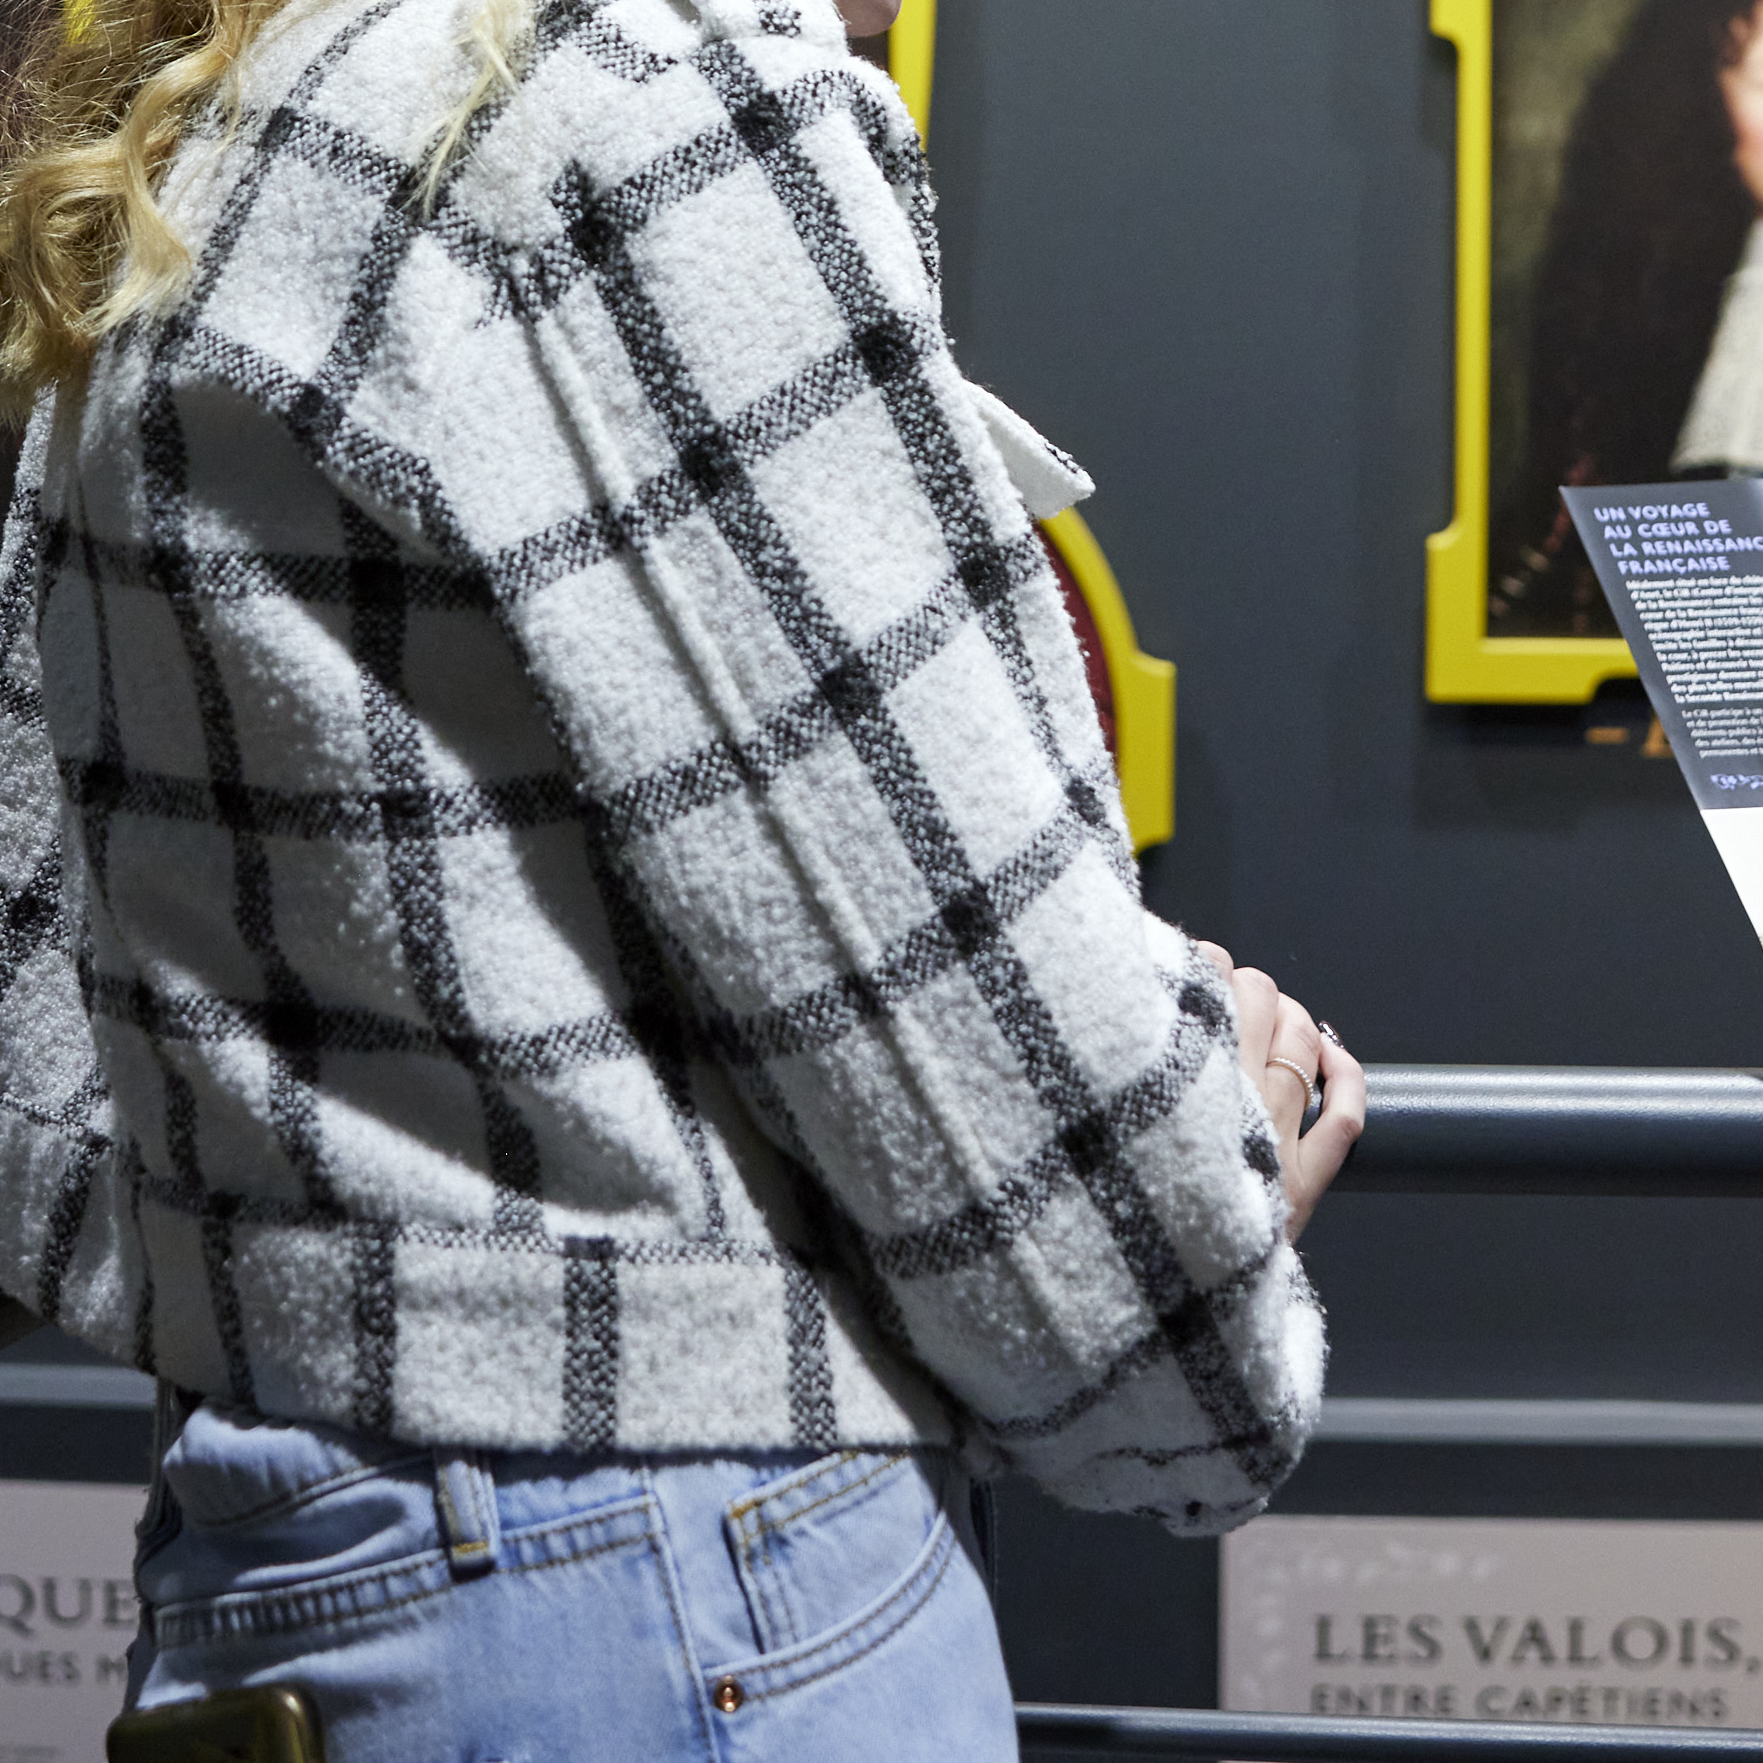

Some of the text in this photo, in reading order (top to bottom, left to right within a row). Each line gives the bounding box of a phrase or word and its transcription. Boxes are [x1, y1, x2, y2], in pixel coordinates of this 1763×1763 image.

[1593, 502, 1711, 522] UN VOYAGE
[1604, 519, 1733, 540] AU CŒUR DE
[1609, 542, 1638, 558] LA
[1617, 556, 1731, 576] FRANÇAISE
[1314, 1613, 1763, 1674] LES VALOIS,
[1311, 1680, 1730, 1723] ENTRE CAPÉTIENS
